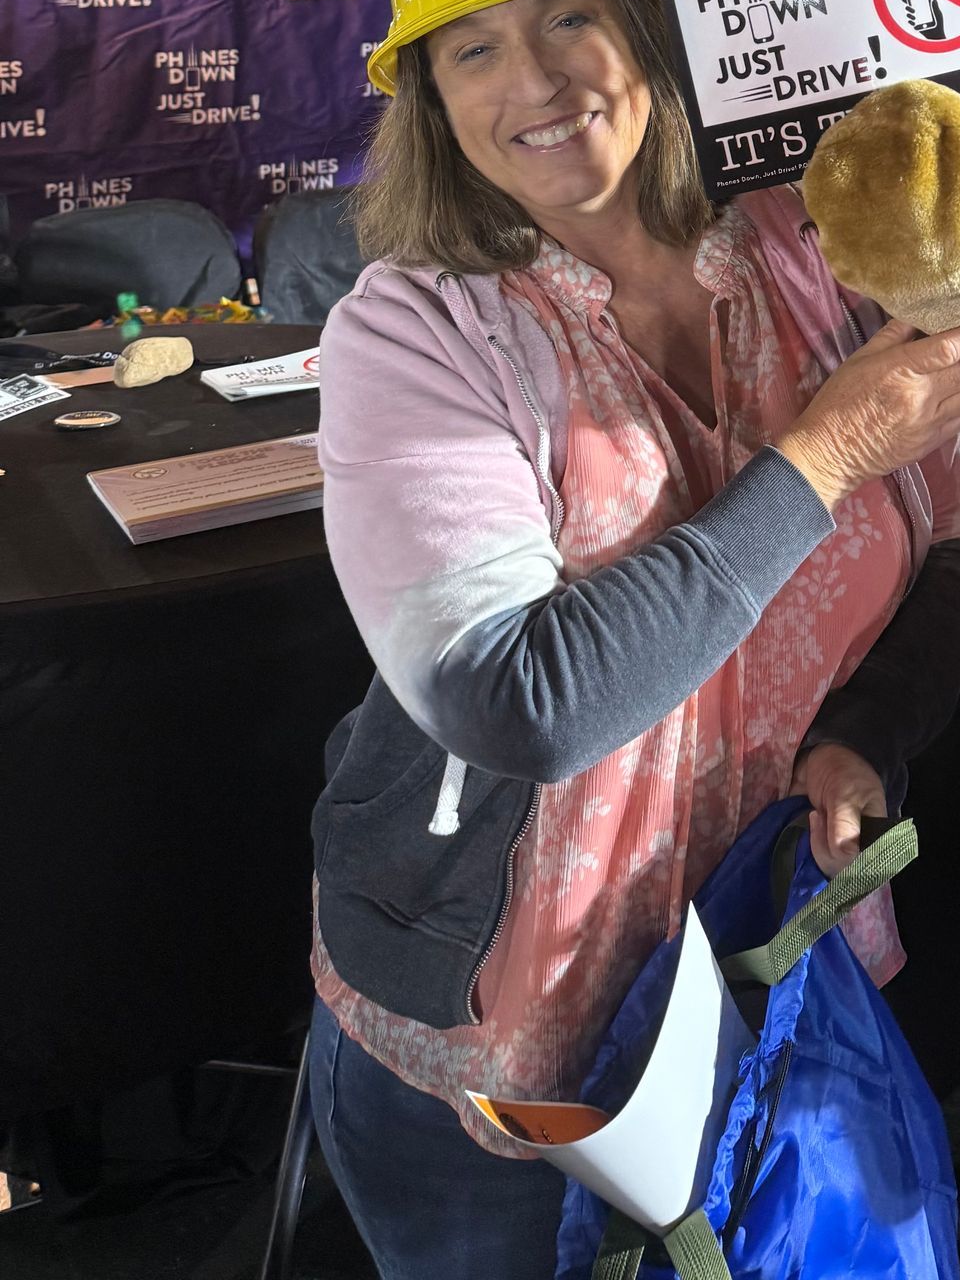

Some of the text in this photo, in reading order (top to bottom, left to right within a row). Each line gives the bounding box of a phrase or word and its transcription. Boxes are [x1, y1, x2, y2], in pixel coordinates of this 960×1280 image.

[716, 44, 786, 84] JUST
[772, 35, 888, 102] DRIVE!
[156, 92, 206, 111] JUST
[191, 94, 261, 125] DRIVE!
[0, 108, 46, 138] IVE!
[715, 120, 808, 171] IT'S
